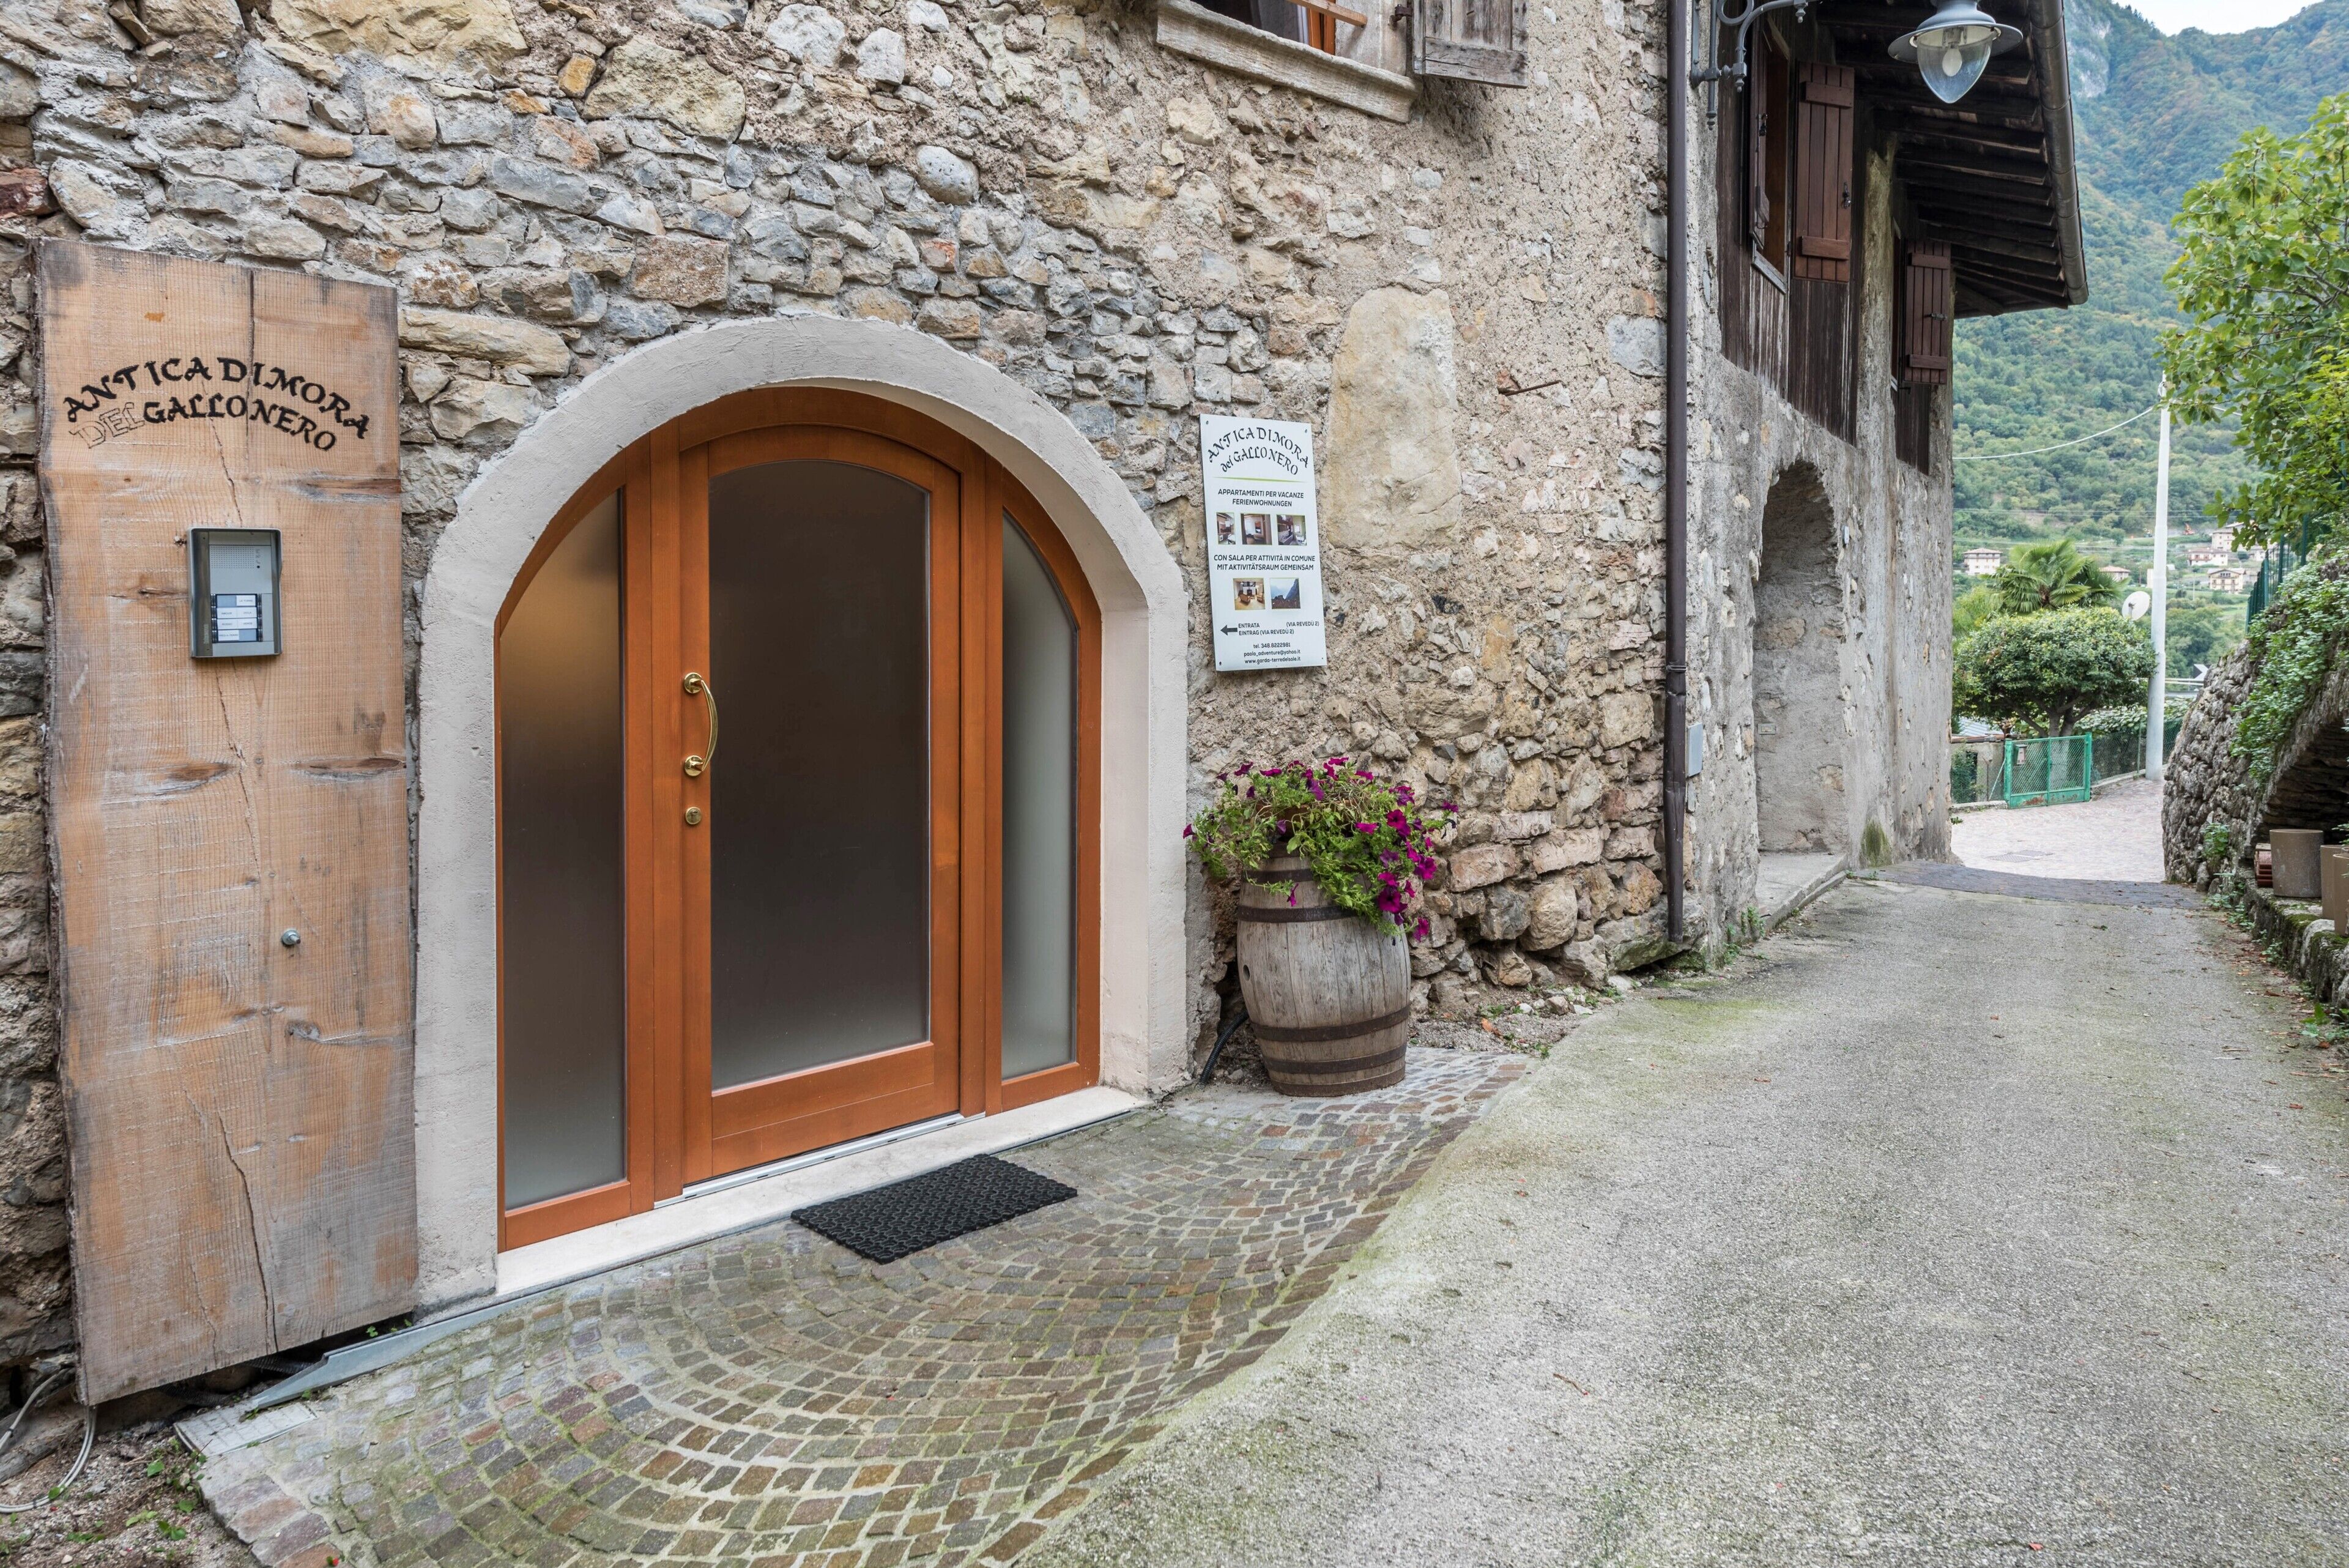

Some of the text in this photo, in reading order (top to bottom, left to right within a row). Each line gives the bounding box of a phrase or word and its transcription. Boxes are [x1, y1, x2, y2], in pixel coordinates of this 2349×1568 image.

[63, 357, 369, 439] ANTICA DIMORA
[69, 392, 336, 451] DEL GALLO NERO
[1208, 427, 1308, 468] ANTICA DIMORA
[1220, 446, 1299, 475] del GALLO NERO
[1244, 649, 1301, 658] paolo_adventure@yahoo.it
[1244, 656, 1301, 665] www.garda-terredelsole.it
